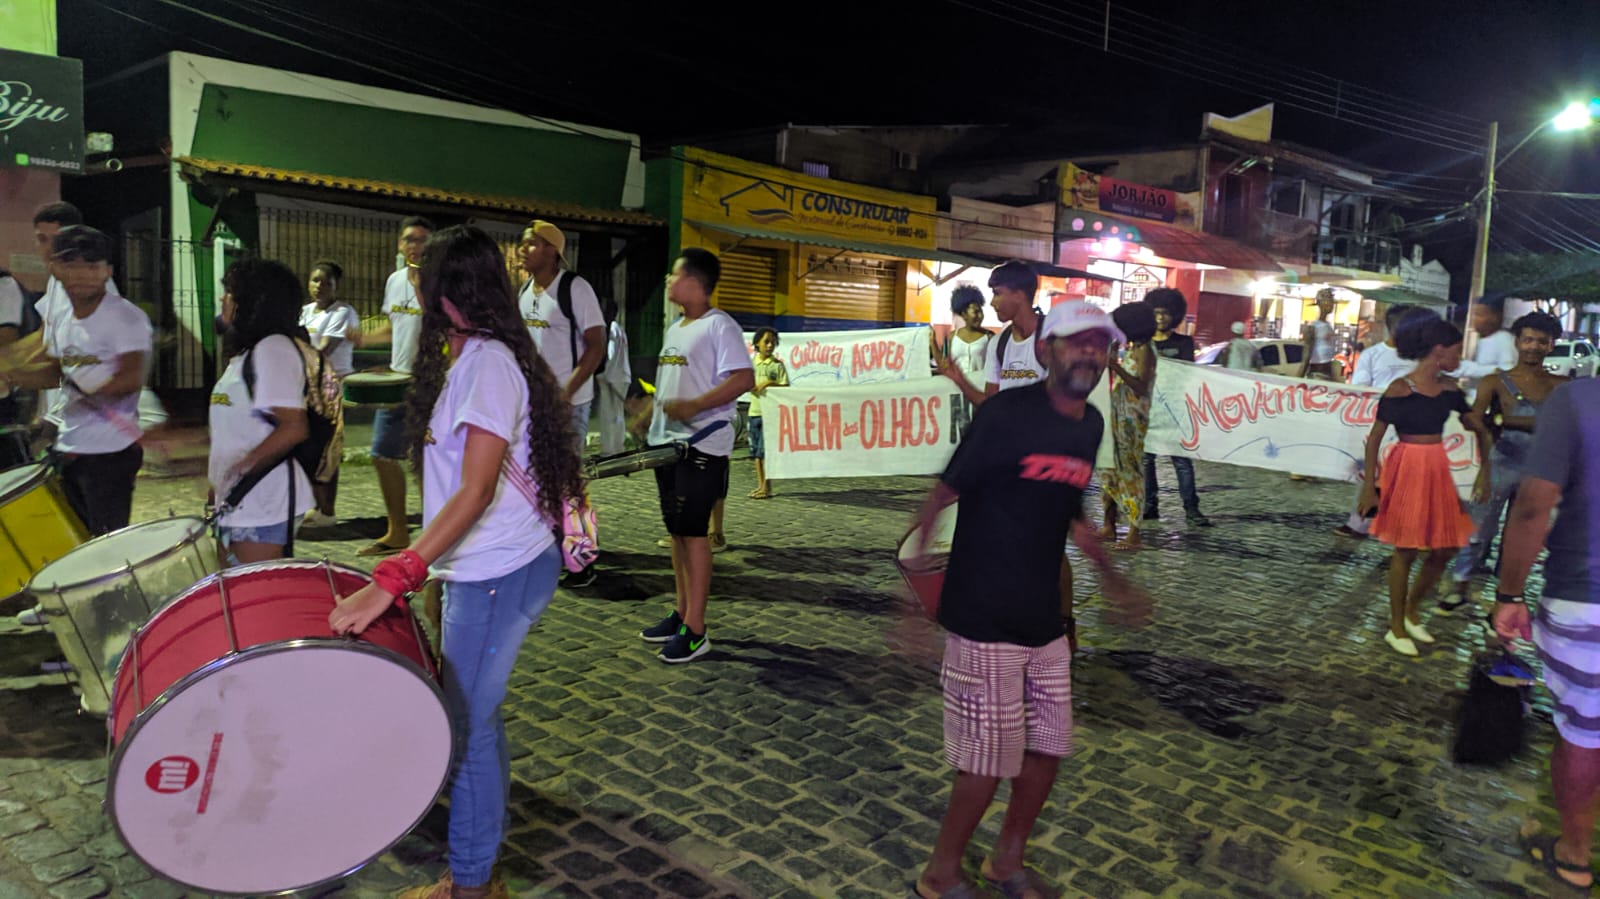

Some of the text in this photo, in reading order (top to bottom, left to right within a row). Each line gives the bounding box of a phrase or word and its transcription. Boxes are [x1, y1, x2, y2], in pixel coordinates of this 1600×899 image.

[801, 192, 911, 224] CONSTRULAR
[1108, 184, 1167, 207] JORJÃO
[790, 340, 843, 370] Cultura
[851, 341, 905, 377] ACAPEB
[778, 396, 841, 453] ALÉM
[859, 396, 941, 449] OLHOS
